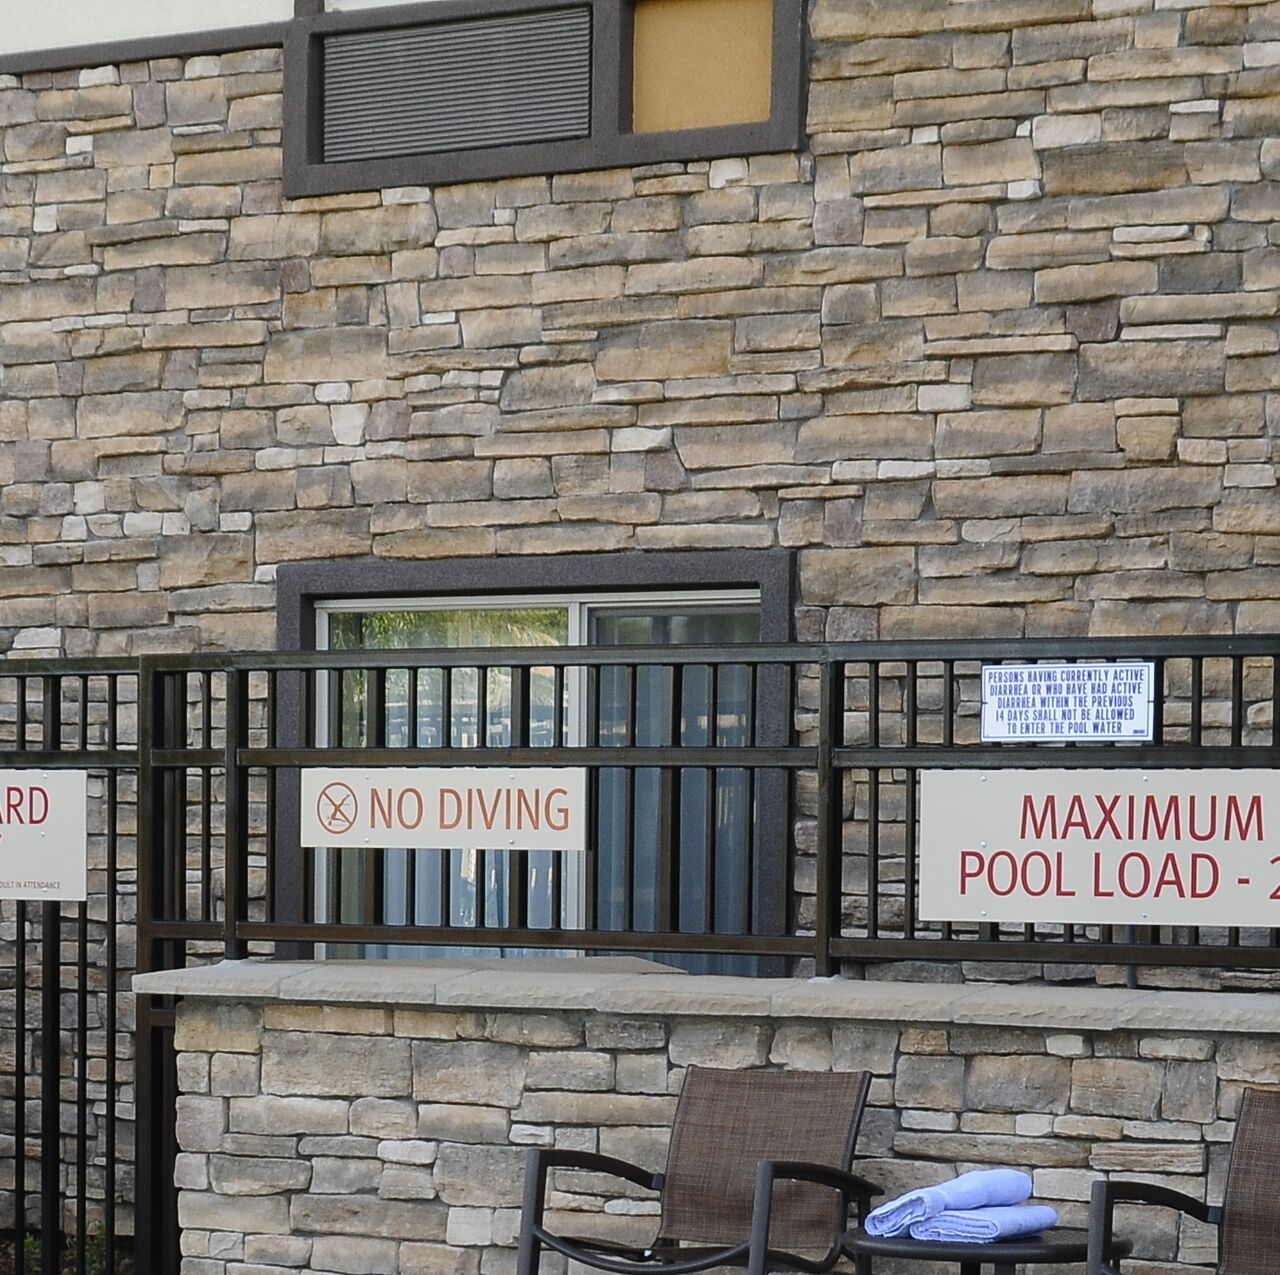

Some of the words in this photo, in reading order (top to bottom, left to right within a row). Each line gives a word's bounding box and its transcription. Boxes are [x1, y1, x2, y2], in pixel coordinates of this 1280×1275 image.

[988, 671, 1024, 684] PERSONS
[1027, 670, 1058, 683] HAVING
[1060, 669, 1110, 682] CURRENTLY
[1112, 669, 1145, 682] ACTIVE
[990, 684, 1028, 696] DIARRHEA
[1031, 684, 1042, 695] OR
[1045, 683, 1063, 695] WHO
[1066, 683, 1088, 695] HAVE
[1091, 682, 1108, 695] HAD
[1110, 682, 1143, 694] ACTIVE
[997, 696, 1036, 708] DIARRHEA
[1040, 696, 1070, 708] WITHIN
[1073, 696, 1088, 708] THE
[1091, 695, 1134, 708] PREVIOUS
[995, 710, 1004, 722] 14
[1007, 709, 1029, 722] DAYS
[1032, 709, 1058, 721] SHALL
[1061, 709, 1078, 721] NOT
[1081, 708, 1091, 721] BE
[1094, 708, 1135, 720] ALLOWED
[1007, 723, 1017, 734] TO
[1020, 722, 1046, 734] ENTER
[1050, 722, 1064, 734] THE
[1068, 722, 1089, 734] POOL
[1092, 721, 1123, 734] WATER
[370, 788, 423, 830] NO
[439, 788, 569, 831] DIVING
[1020, 794, 1265, 841] MAXIMUM
[960, 851, 1076, 897] POOL
[1094, 852, 1220, 898] LOAD
[23, 881, 61, 889] ATTENDANCE
